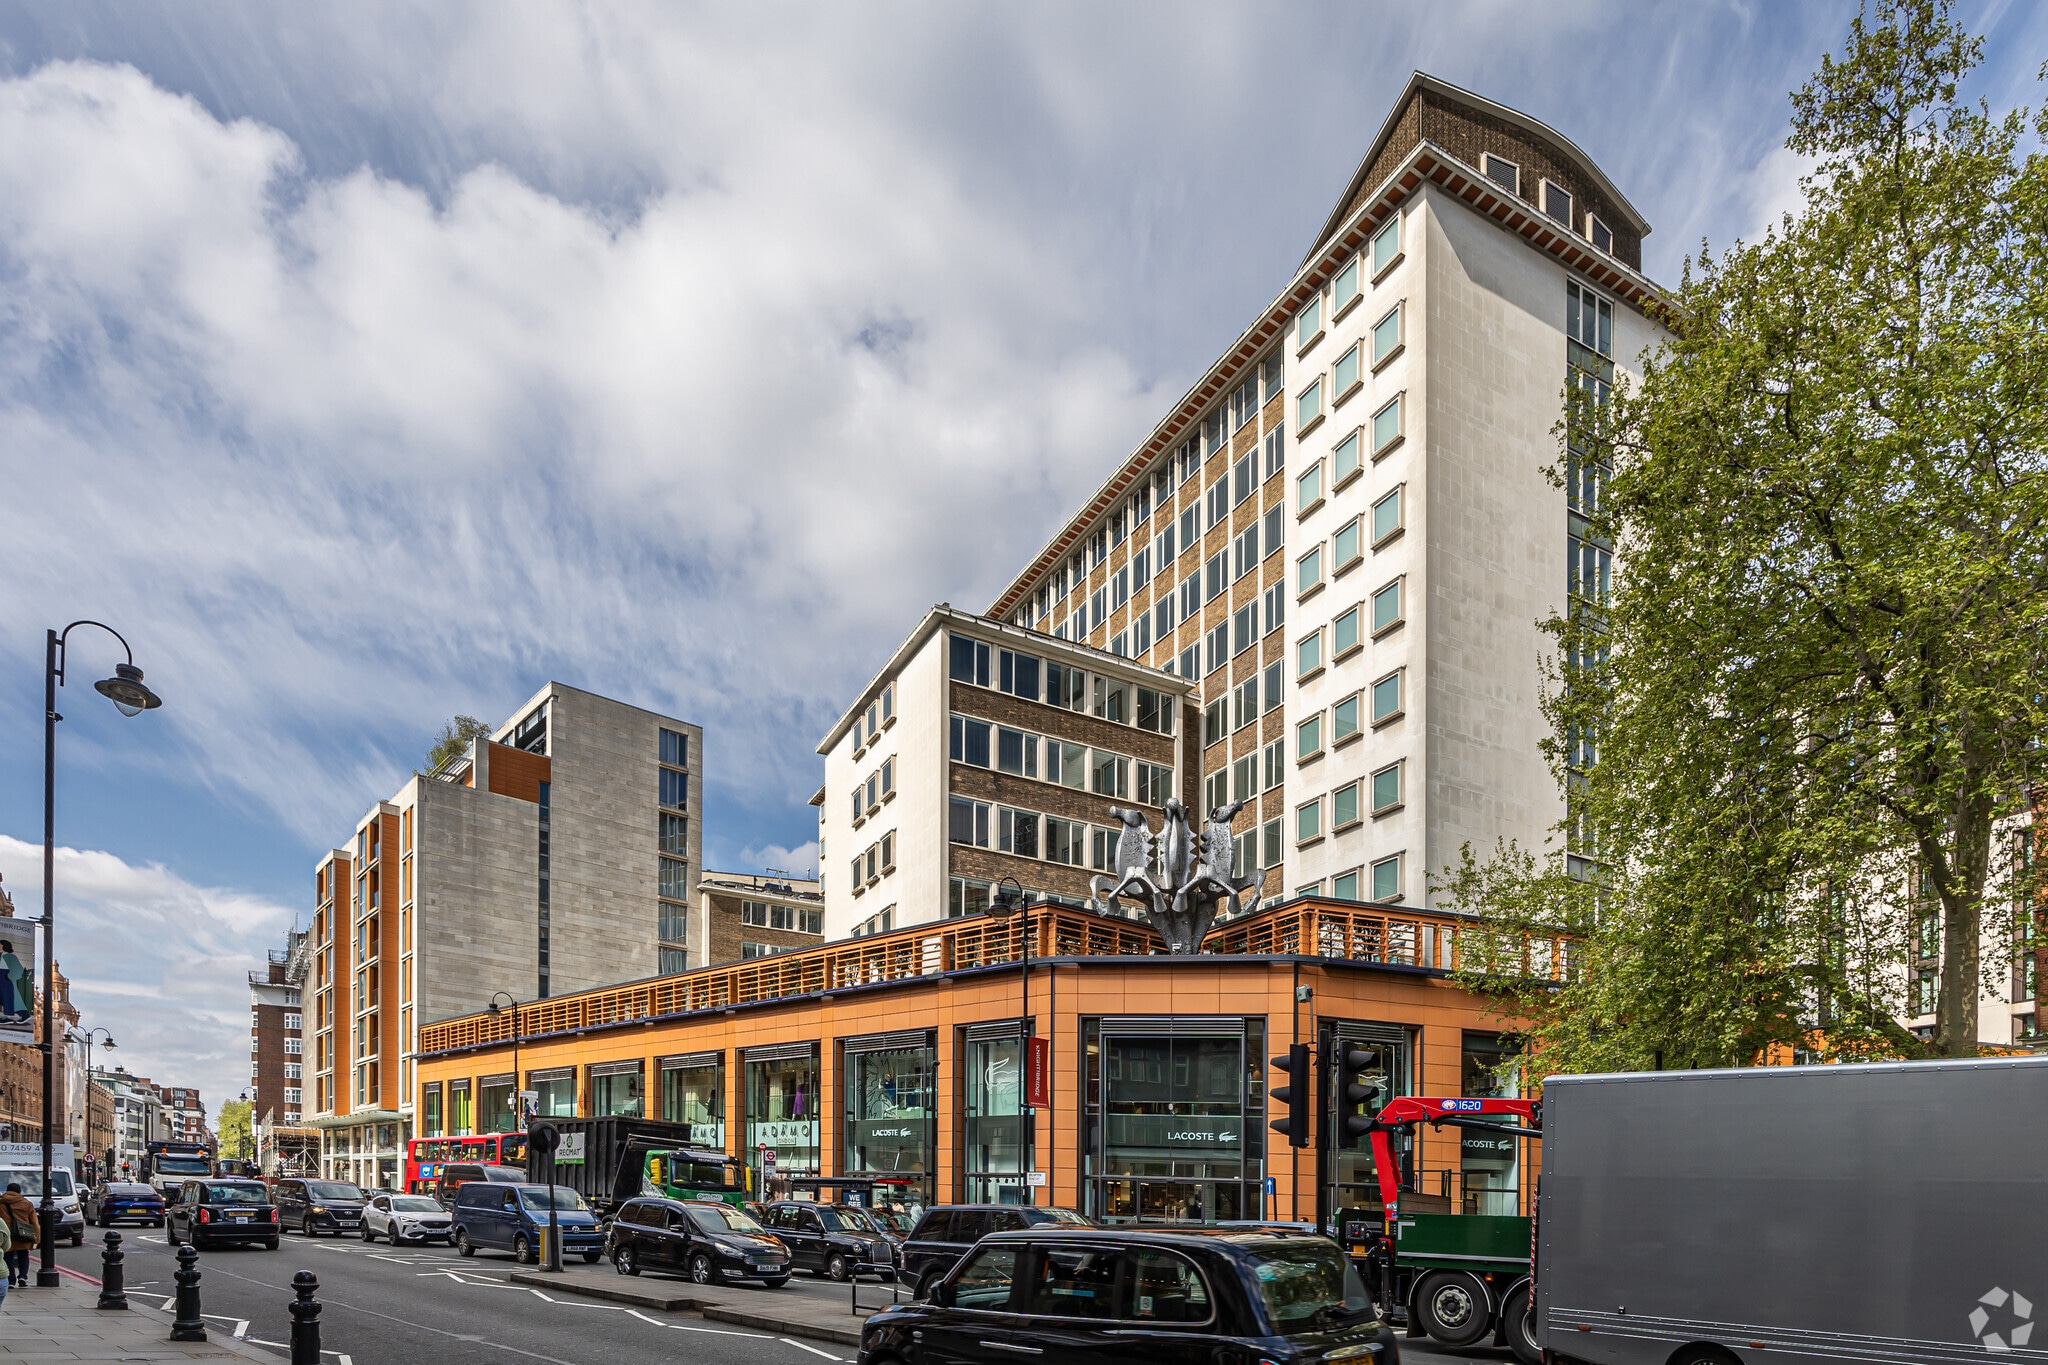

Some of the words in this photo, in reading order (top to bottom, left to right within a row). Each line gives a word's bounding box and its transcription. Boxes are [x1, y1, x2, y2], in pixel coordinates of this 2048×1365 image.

[1459, 1101, 1481, 1110] 1620
[1167, 1132, 1214, 1140] LACOSTE
[1462, 1140, 1495, 1148] ACOSTE
